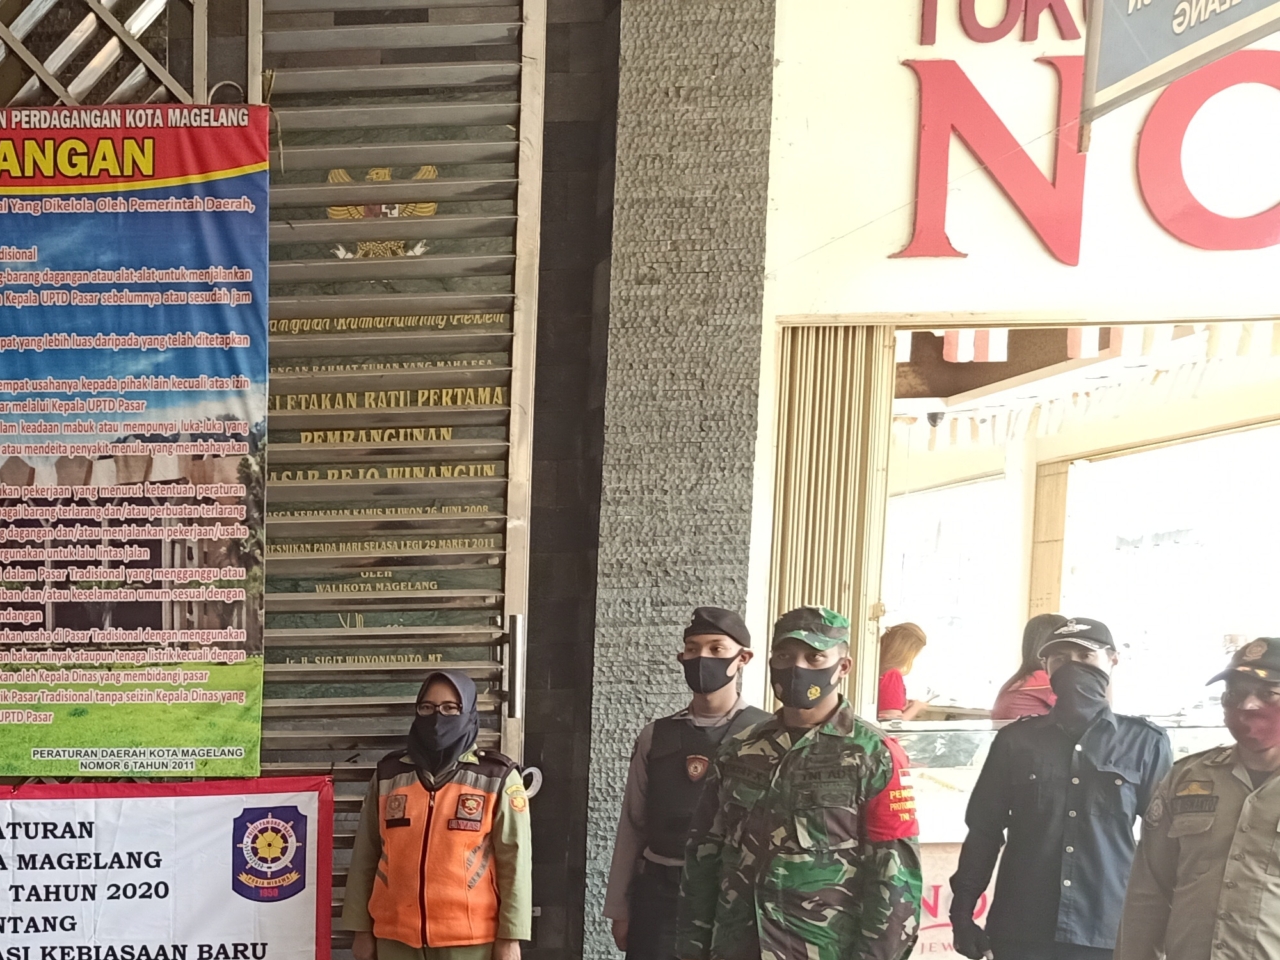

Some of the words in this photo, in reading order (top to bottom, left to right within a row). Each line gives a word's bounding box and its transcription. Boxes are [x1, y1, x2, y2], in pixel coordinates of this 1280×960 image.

[11, 109, 120, 129] PERDAGANGAN
[125, 108, 163, 128] KOTA
[168, 108, 249, 127] MAGELANG
[10, 199, 40, 217] Yang
[42, 198, 93, 214] Dikelola
[96, 198, 126, 213] Oleh
[128, 196, 204, 213] Pemerintah
[205, 196, 255, 213] Daerah,
[42, 267, 89, 286] dagangan
[90, 269, 114, 283] atau
[115, 266, 155, 283] alat-alat
[157, 266, 188, 282] untuk
[188, 265, 252, 284] menjalankan
[417, 387, 503, 406] PERTAMA
[7, 525, 54, 542] dagangan
[55, 523, 100, 541] dan/atau
[101, 522, 164, 542] menjalankan
[166, 523, 249, 541] pekerjaan/usaha
[314, 543, 337, 552] PADA
[339, 542, 362, 551] HARI
[364, 541, 398, 551] SELASA
[401, 541, 422, 550] LEGI
[425, 540, 436, 549] 29
[439, 539, 470, 548] MARET
[472, 538, 495, 548] 2011
[315, 583, 372, 593] WALIKOTA
[376, 581, 438, 591] MAGELANG
[12, 690, 38, 703] Pasar
[40, 690, 93, 703] Tradisional
[95, 691, 124, 705] tanpa
[125, 689, 153, 703] seizin
[155, 690, 190, 705] Kepala
[191, 689, 219, 702] Dinas
[220, 691, 245, 704] yang
[26, 711, 53, 723] Pasar
[32, 749, 98, 759] PERATURAN
[101, 748, 146, 758] DAERAH
[149, 748, 178, 758] KOTA
[180, 748, 243, 758] MAGELANG
[80, 760, 120, 770] NOMOR
[123, 761, 130, 770] 6
[132, 760, 169, 770] TAHUN
[171, 760, 195, 770] 2011
[16, 851, 162, 871] MAGELANG
[8, 884, 97, 902] TAHUN
[106, 881, 170, 900] 2020
[259, 888, 279, 897] 1950
[197, 942, 268, 960] BARU
